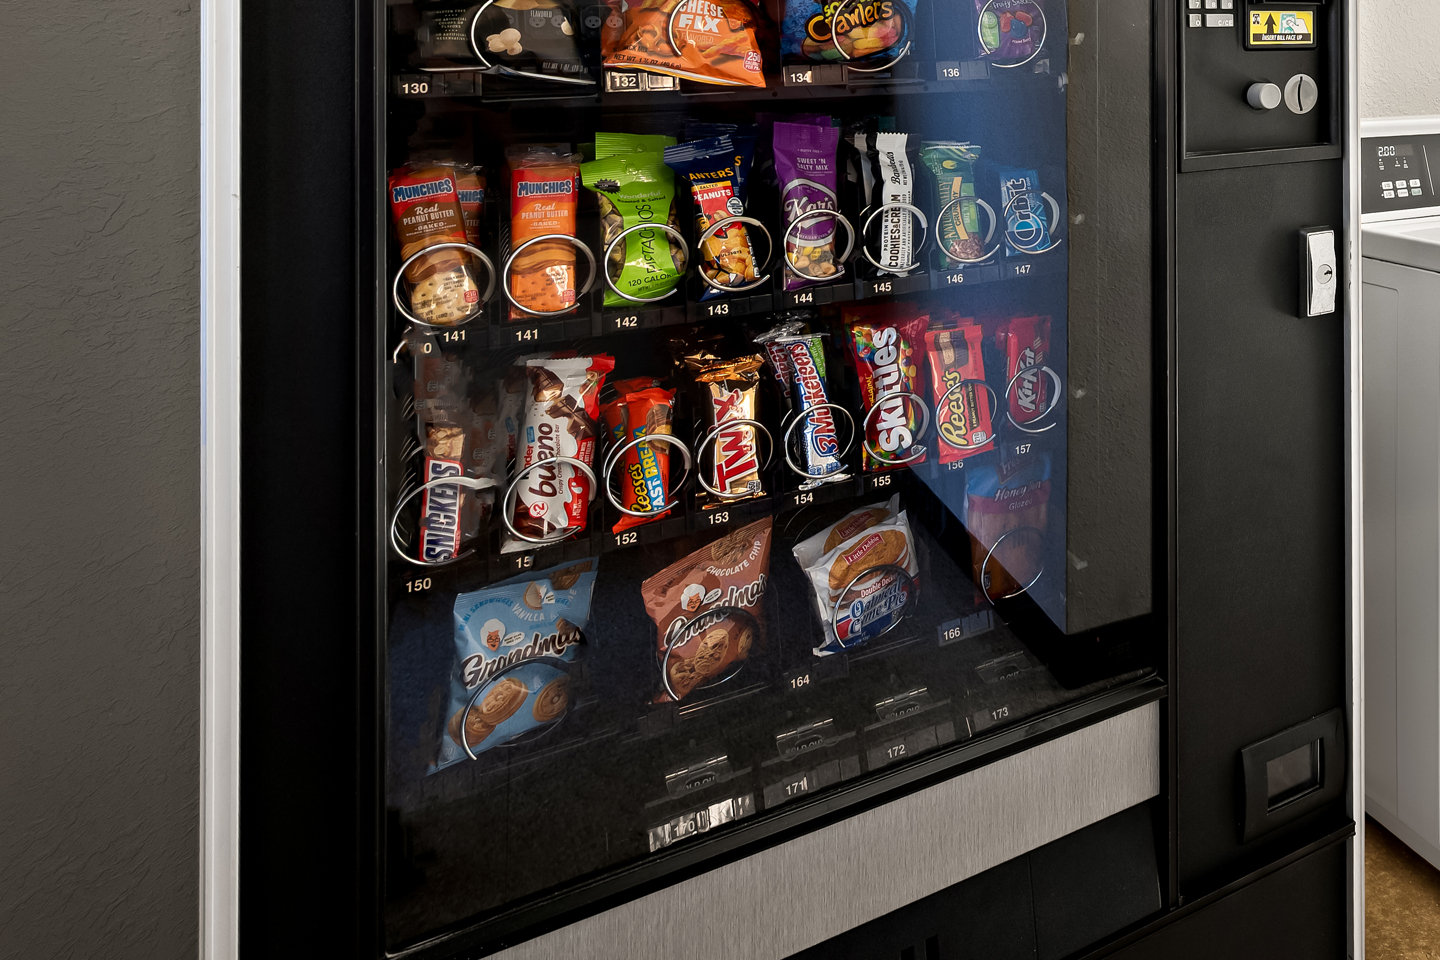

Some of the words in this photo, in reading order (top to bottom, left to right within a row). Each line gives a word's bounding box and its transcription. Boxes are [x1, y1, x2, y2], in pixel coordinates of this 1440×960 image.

[680, 0, 724, 17] CHEESE
[678, 14, 721, 33] FIX
[808, 1, 893, 41] Crawlers
[1286, 33, 1296, 41] FACE
[790, 73, 808, 83] 134
[942, 68, 960, 78] 136
[402, 83, 428, 94] 130
[614, 77, 636, 87] 132
[816, 163, 828, 171] MIX
[684, 167, 734, 181] LANTERS
[393, 178, 454, 203] MUNCHIES
[518, 181, 573, 196] MUNCHIES
[694, 188, 732, 202] PEANUTS
[415, 203, 439, 215] Real
[534, 202, 556, 211] Real
[403, 213, 429, 226] PEANUT
[431, 209, 454, 221] BUTTER
[522, 211, 545, 220] PEANUT
[547, 210, 568, 218] BUTTER
[1015, 265, 1031, 275] 147
[628, 278, 642, 288] 120
[946, 274, 964, 284] 146
[873, 282, 892, 293] 145
[793, 293, 813, 304] 144
[708, 304, 729, 316] 143
[615, 316, 638, 328] 142
[443, 330, 466, 342] 141
[516, 329, 538, 341] 141
[873, 326, 913, 453] Skittles
[941, 369, 968, 446] Reese's
[707, 389, 758, 493] TWIX
[818, 436, 839, 457] 3
[1015, 444, 1031, 455] 157
[529, 422, 556, 499] bueno
[947, 461, 964, 472] 156
[873, 475, 891, 488] 155
[794, 492, 814, 505] 154
[994, 486, 1027, 502] Honey
[425, 461, 462, 563] SNICKERS
[708, 512, 729, 525] 153
[615, 532, 637, 545] 152
[847, 548, 863, 563] Little
[862, 535, 881, 552] Debbie
[706, 557, 749, 576] CHOCOLATE
[748, 540, 762, 561] CHIP
[405, 577, 432, 592] 150
[861, 584, 880, 597] Double
[512, 603, 546, 622] VANILLA
[944, 627, 960, 640] 166
[790, 675, 810, 688] 164
[991, 706, 1010, 721] 173
[886, 744, 907, 759] 172
[785, 779, 807, 796] 171
[674, 819, 696, 836] 170
